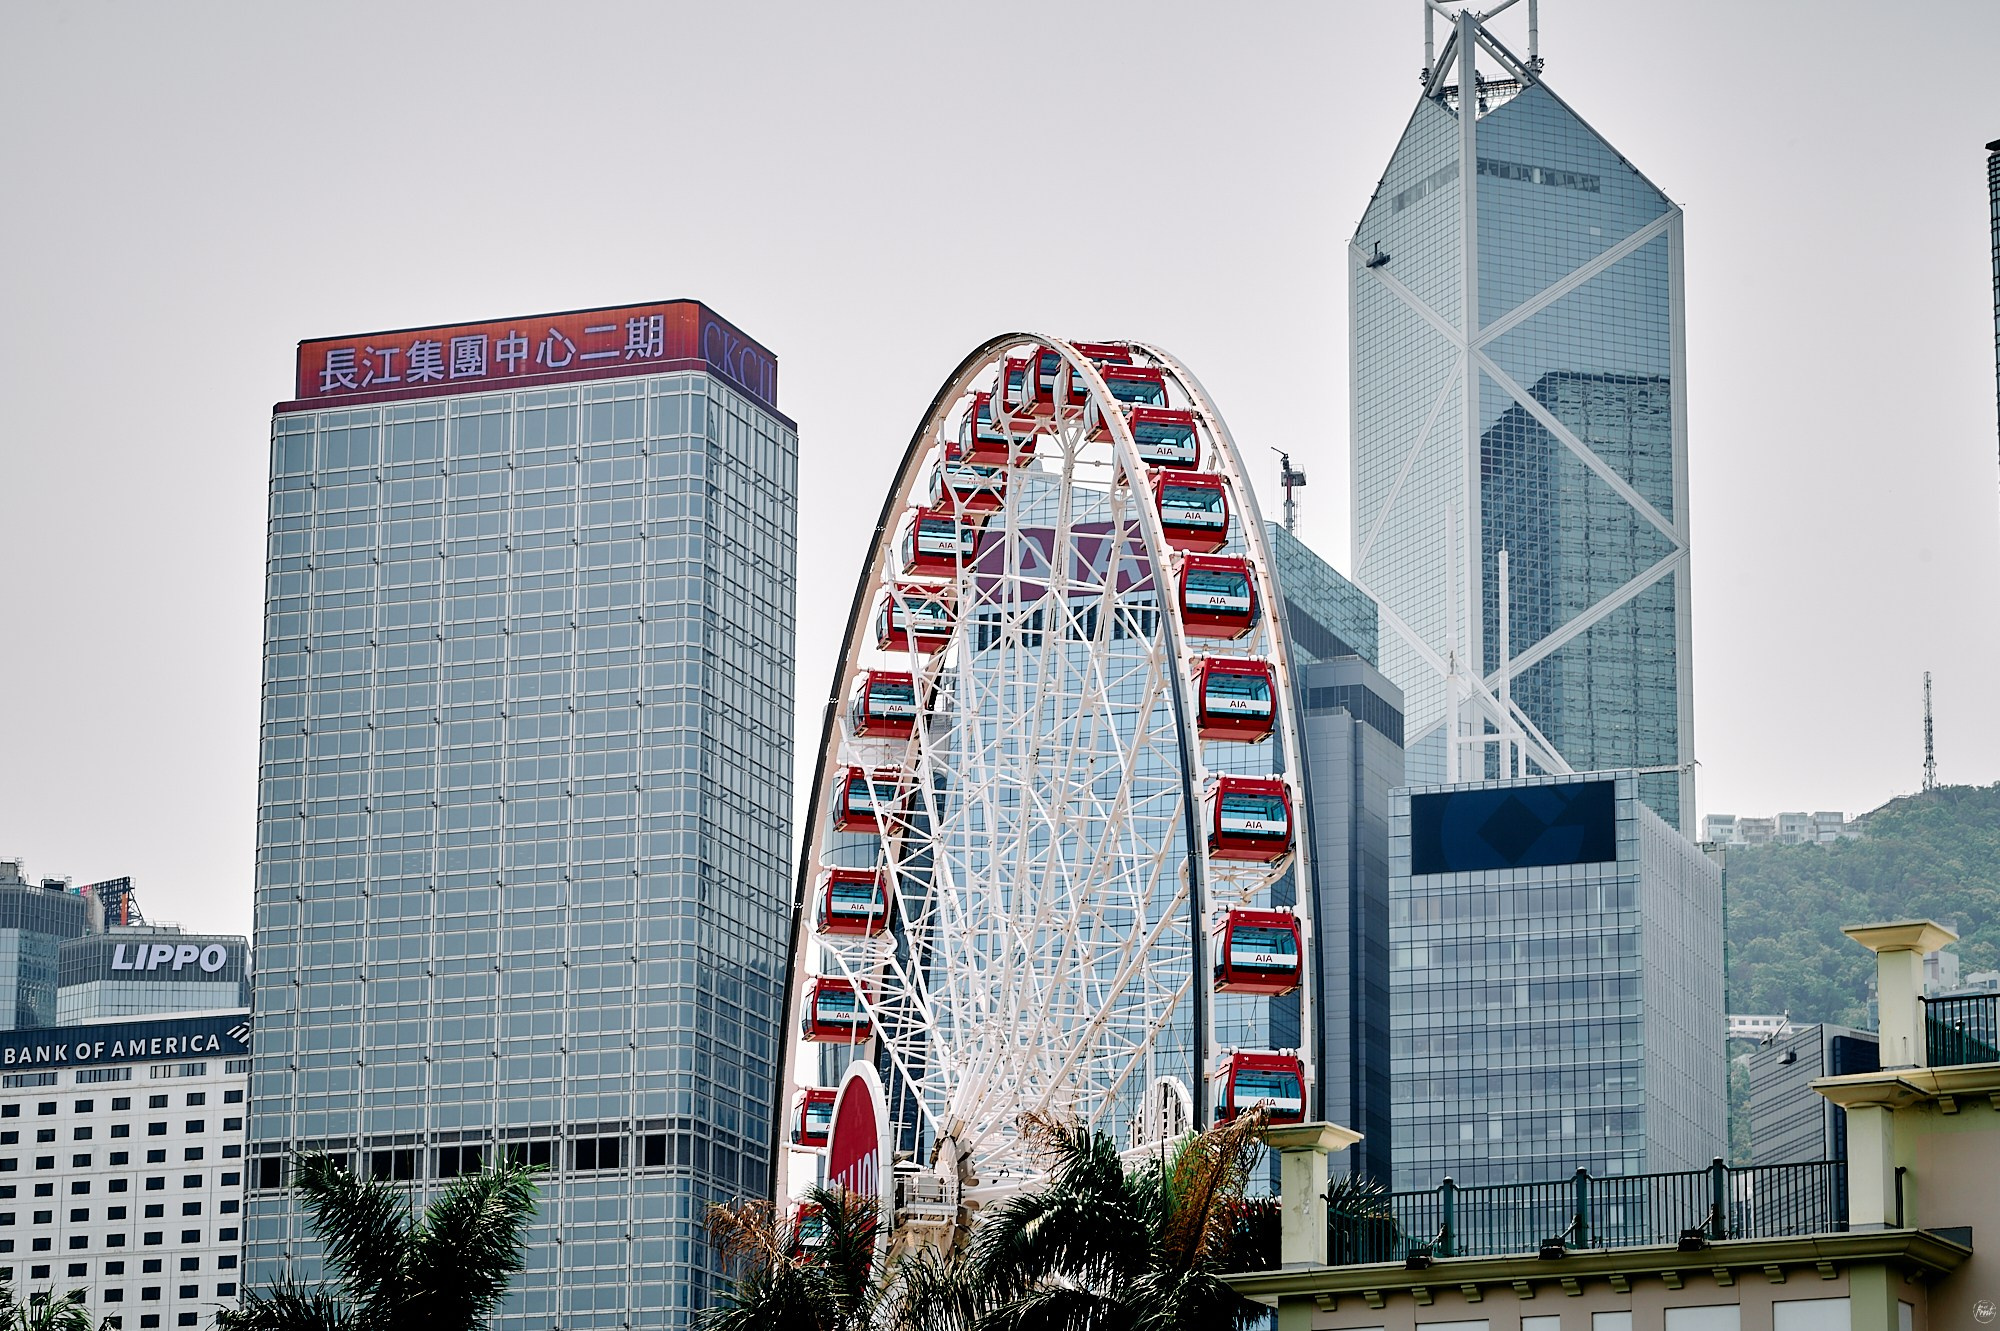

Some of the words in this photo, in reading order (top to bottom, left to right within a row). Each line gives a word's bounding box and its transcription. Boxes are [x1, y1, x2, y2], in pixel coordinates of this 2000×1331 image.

[318, 314, 665, 392] 長江集團中心二期
[1156, 447, 1174, 456] AIA
[1184, 511, 1202, 520] AIA
[938, 541, 954, 549] AIA
[1209, 596, 1227, 605] AIA
[888, 704, 903, 712] AIA
[1229, 700, 1247, 709] AIA
[1245, 820, 1263, 829] AIA
[111, 943, 227, 973] LIPPO
[1255, 954, 1273, 963] AIA
[4, 1044, 67, 1065] BANK
[75, 1041, 105, 1060] OF
[111, 1033, 221, 1057] AMERICA
